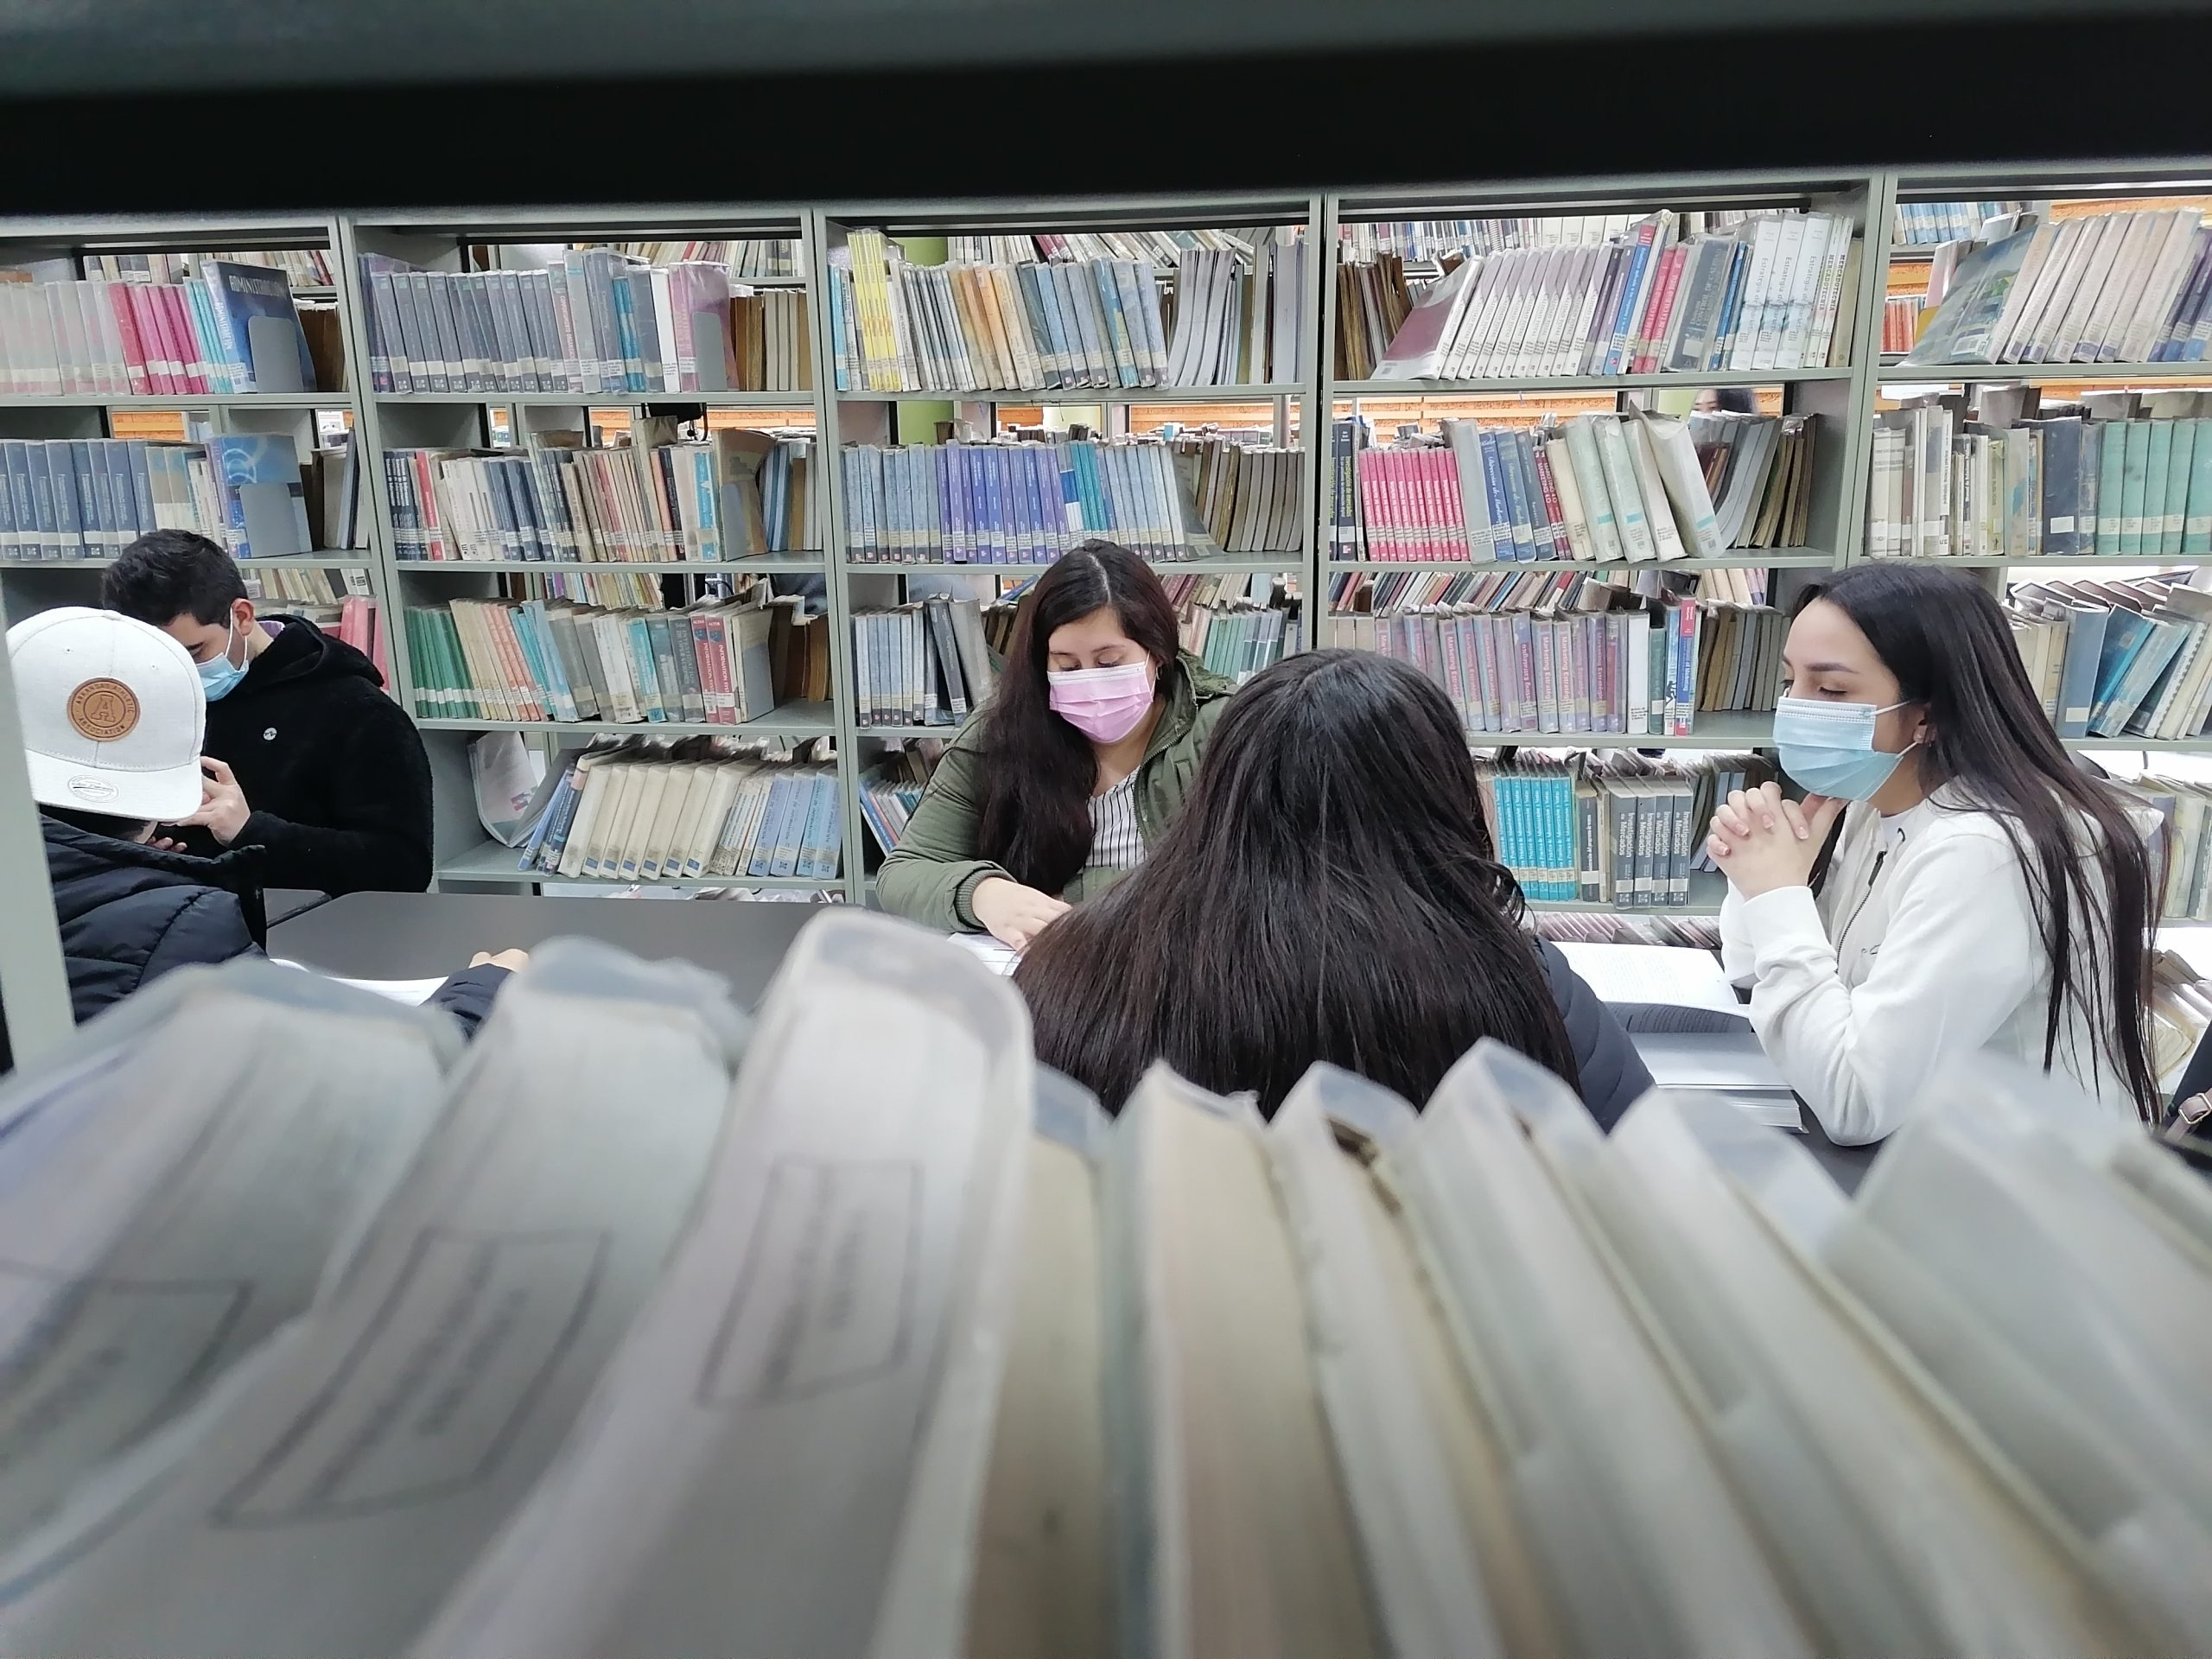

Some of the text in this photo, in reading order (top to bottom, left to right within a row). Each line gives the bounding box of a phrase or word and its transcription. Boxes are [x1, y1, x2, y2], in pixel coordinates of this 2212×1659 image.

[1819, 254, 1834, 311] MERCADOTECNIA
[1829, 254, 1846, 311] MERCADOTECNIA
[703, 642, 713, 678] INFORMATION
[719, 645, 728, 680] INFORMATION
[1447, 636, 1456, 671] Marketing
[76, 683, 135, 714] ARKANSAS ATHLETIC
[91, 695, 116, 722] A
[78, 718, 125, 735] ASSOCIATION
[1626, 812, 1636, 858] Investigación
[1645, 812, 1654, 858] Investigación
[1662, 811, 1670, 856] Investigación
[1674, 820, 1682, 855] Mercados
[1681, 811, 1690, 857] Investigación
